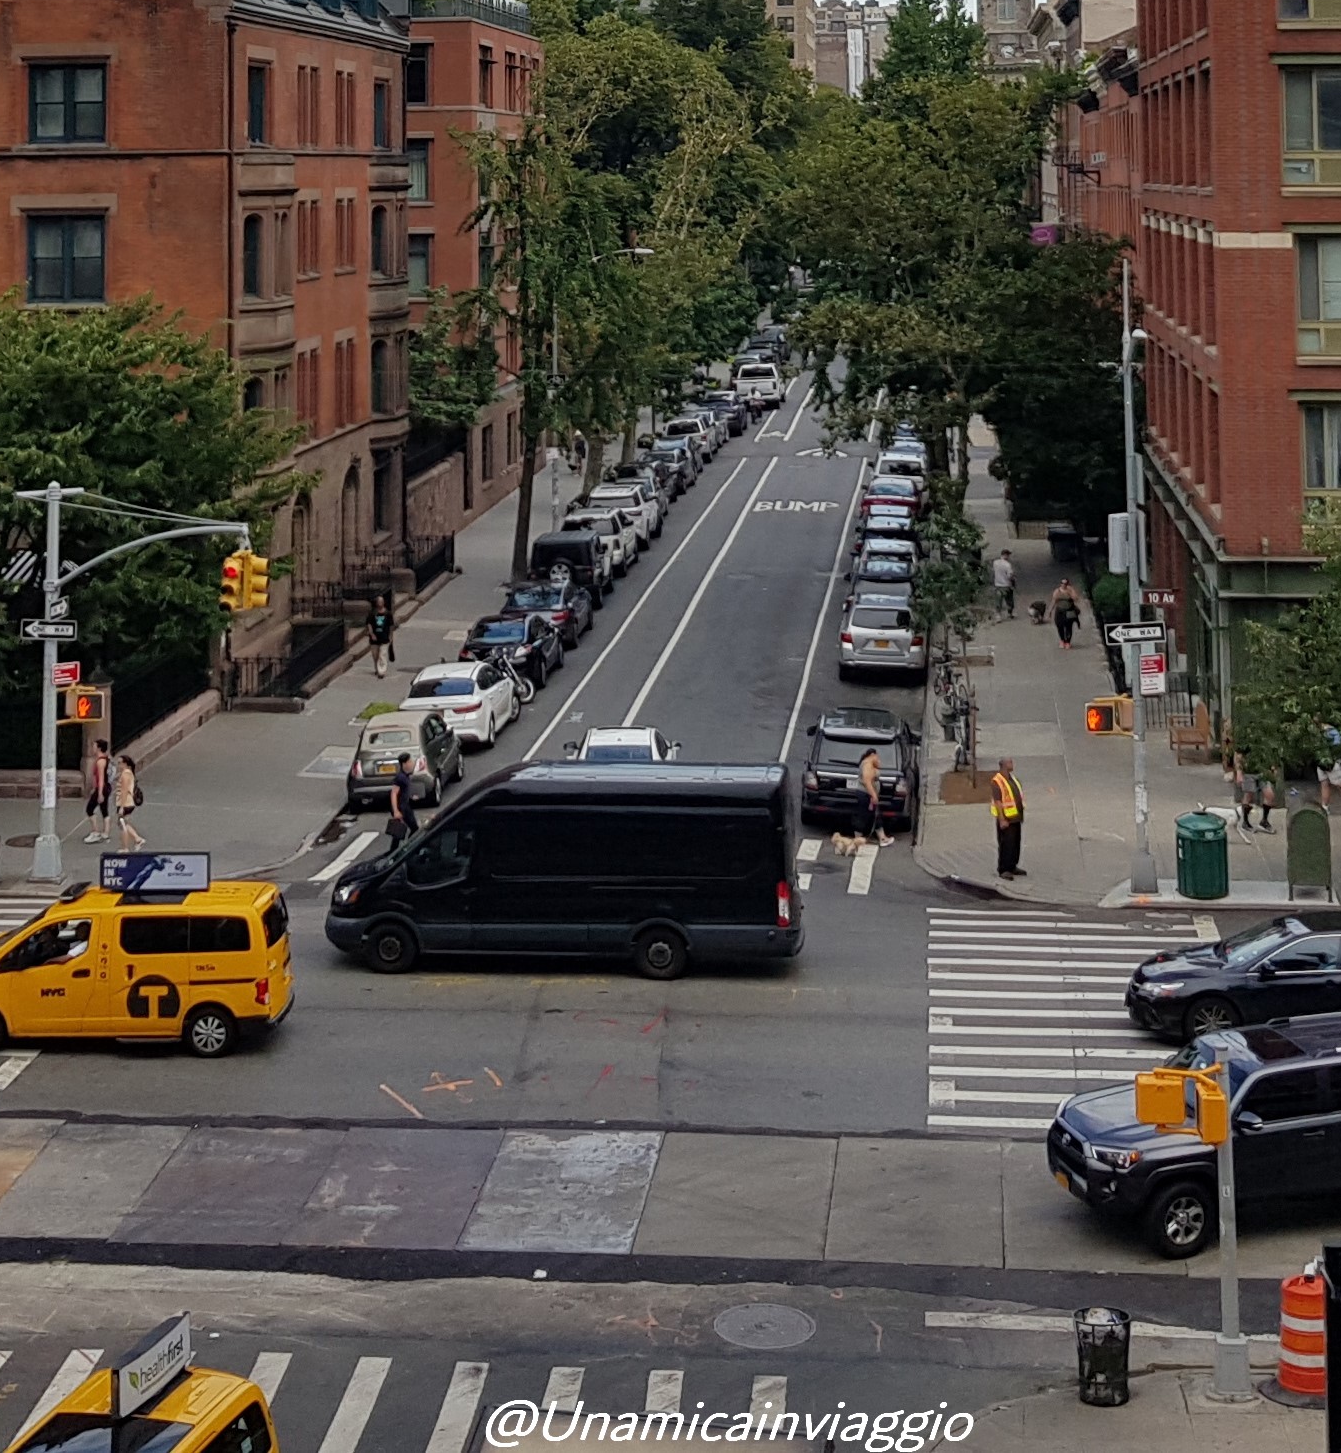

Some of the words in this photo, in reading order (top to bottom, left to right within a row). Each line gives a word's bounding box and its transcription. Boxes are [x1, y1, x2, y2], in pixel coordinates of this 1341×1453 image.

[753, 500, 839, 512] BUMP
[1148, 593, 1159, 603] 10
[1162, 593, 1175, 603] Av
[1115, 630, 1131, 638] ONE
[103, 859, 128, 868] NOW
[103, 868, 115, 877] IN
[103, 877, 123, 886] NYC
[41, 988, 66, 997] NYC
[138, 985, 169, 1018] T
[140, 1333, 184, 1387] healthfirst
